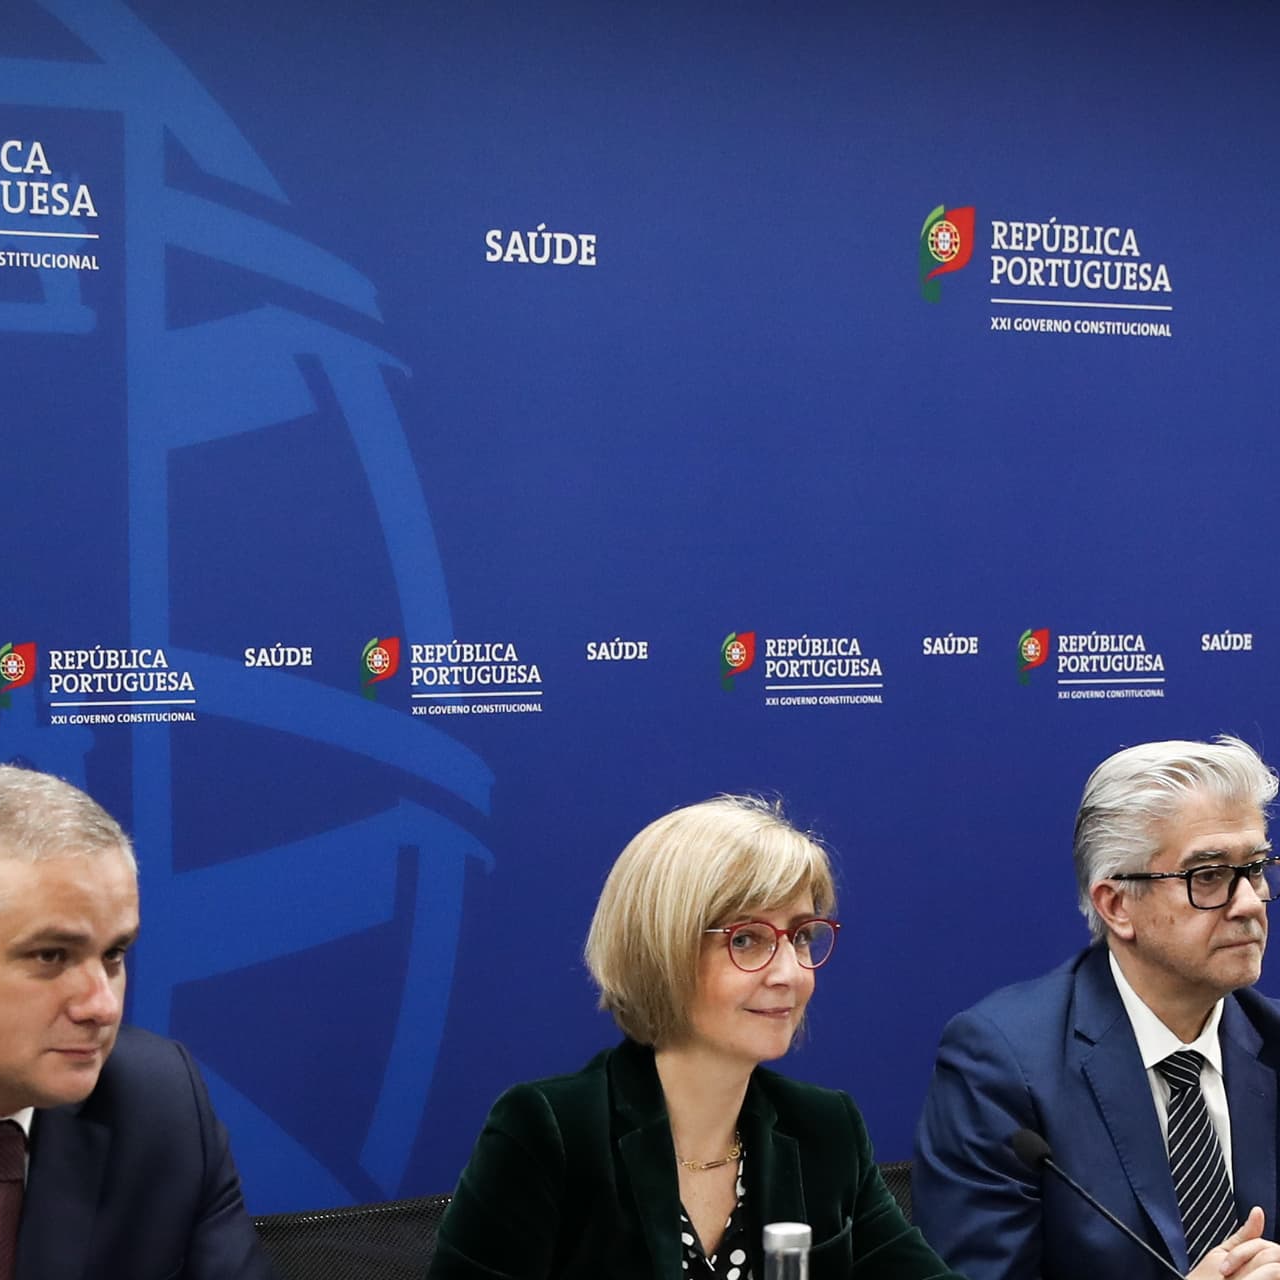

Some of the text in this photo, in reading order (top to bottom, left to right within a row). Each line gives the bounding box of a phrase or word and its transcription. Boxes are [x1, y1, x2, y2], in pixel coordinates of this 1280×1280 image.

[486, 223, 596, 265] SAÚDE
[991, 217, 1140, 257] REPÚBLICA
[991, 256, 1172, 291] PORTUGUESA
[991, 316, 1171, 337] XXI GOVERNO CONSTITUCIONAL
[587, 638, 647, 660] SAÚDE
[766, 634, 861, 656] REPÚBLICA
[924, 633, 978, 654] SAÚDE
[1058, 631, 1145, 652] REPÚBLICA
[1202, 630, 1252, 650] SAÚDE
[49, 645, 168, 669] REPÚBLICA
[245, 643, 312, 666] SAÚDE
[411, 640, 518, 663] REPÚBLICA
[412, 662, 541, 685] PORTUGUESA
[766, 659, 882, 678] PORTUGUESA
[1058, 654, 1164, 672] PORTUGUESA
[50, 672, 194, 693] PORTUGUESA
[51, 711, 195, 725] XXI GOVERNO CONSTITUCIONAL
[412, 703, 542, 715] XXI GOVERNO CONSTITUCIONAL
